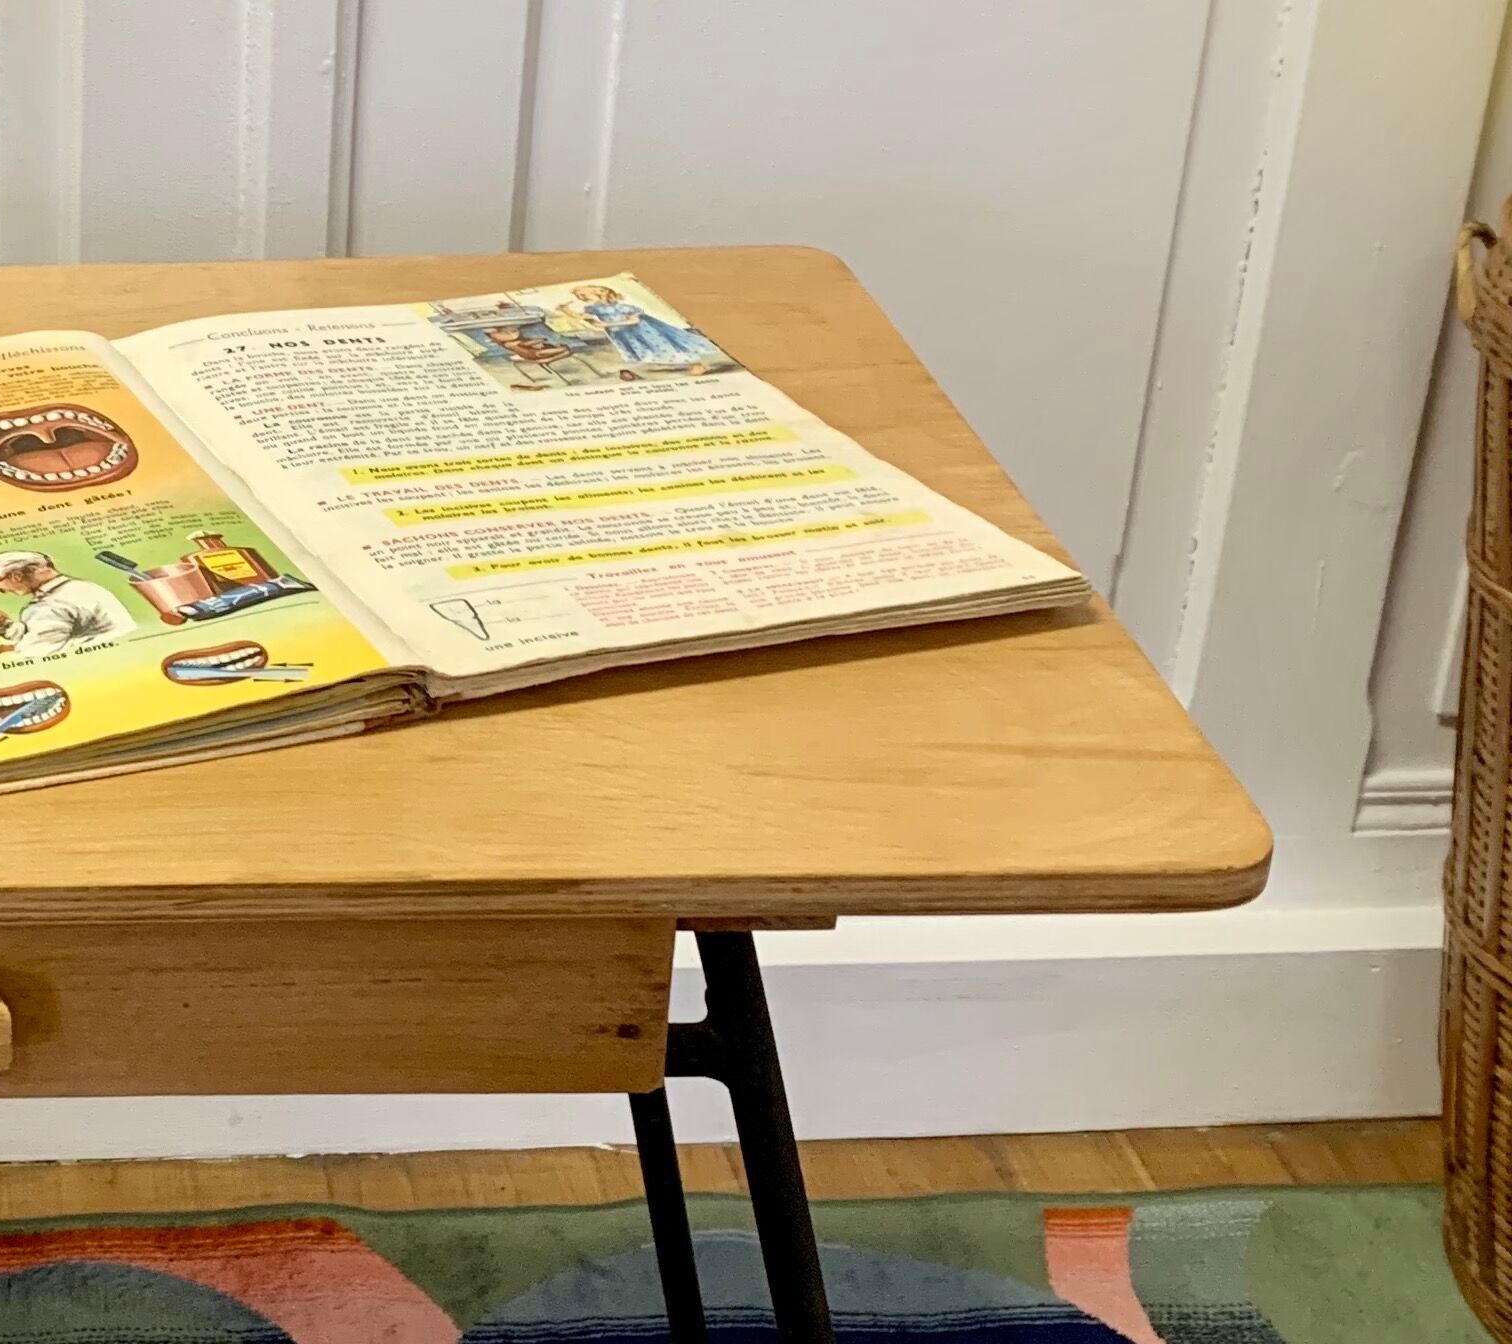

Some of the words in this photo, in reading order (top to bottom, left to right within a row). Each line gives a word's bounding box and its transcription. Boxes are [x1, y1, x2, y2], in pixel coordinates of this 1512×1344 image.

[207, 325, 288, 341] Concluons
[307, 321, 376, 333] Retenons
[269, 339, 310, 349] NOS
[323, 336, 386, 346] DENTS
[6, 368, 45, 378] votre
[36, 501, 72, 512] dent
[381, 530, 458, 546] SACHONS
[463, 520, 556, 535] CONSERVER
[489, 561, 520, 570] Pour
[485, 640, 514, 652] une
[519, 629, 580, 646] incisive
[1, 655, 34, 670] bien
[43, 652, 68, 664] nos
[75, 640, 120, 658] dents.
